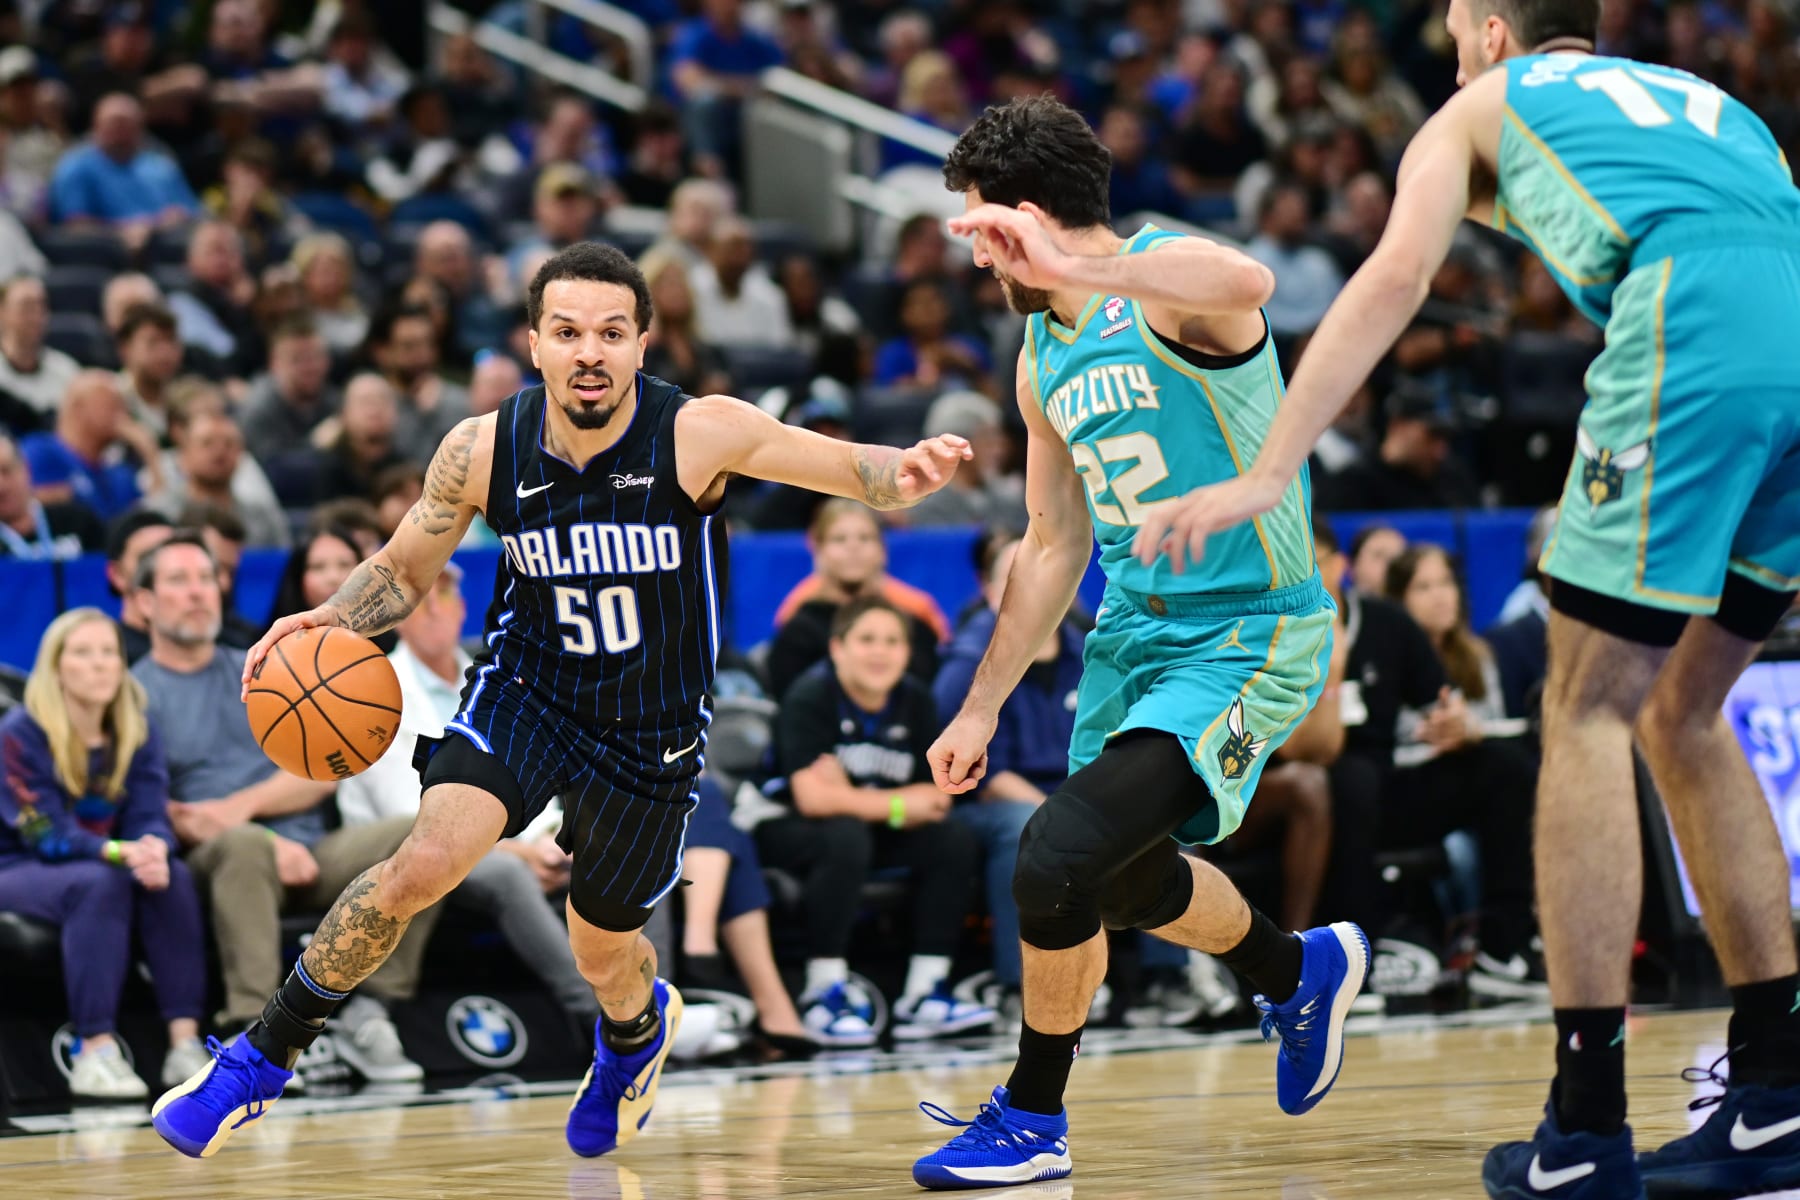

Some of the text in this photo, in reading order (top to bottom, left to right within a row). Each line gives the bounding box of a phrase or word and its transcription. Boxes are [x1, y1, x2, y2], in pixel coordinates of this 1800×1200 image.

[1100, 317, 1132, 339] FEASTABLES
[1087, 363, 1161, 413] CITY
[1071, 430, 1179, 526] 22
[501, 522, 682, 578] ORLANDO
[553, 584, 642, 656] 50
